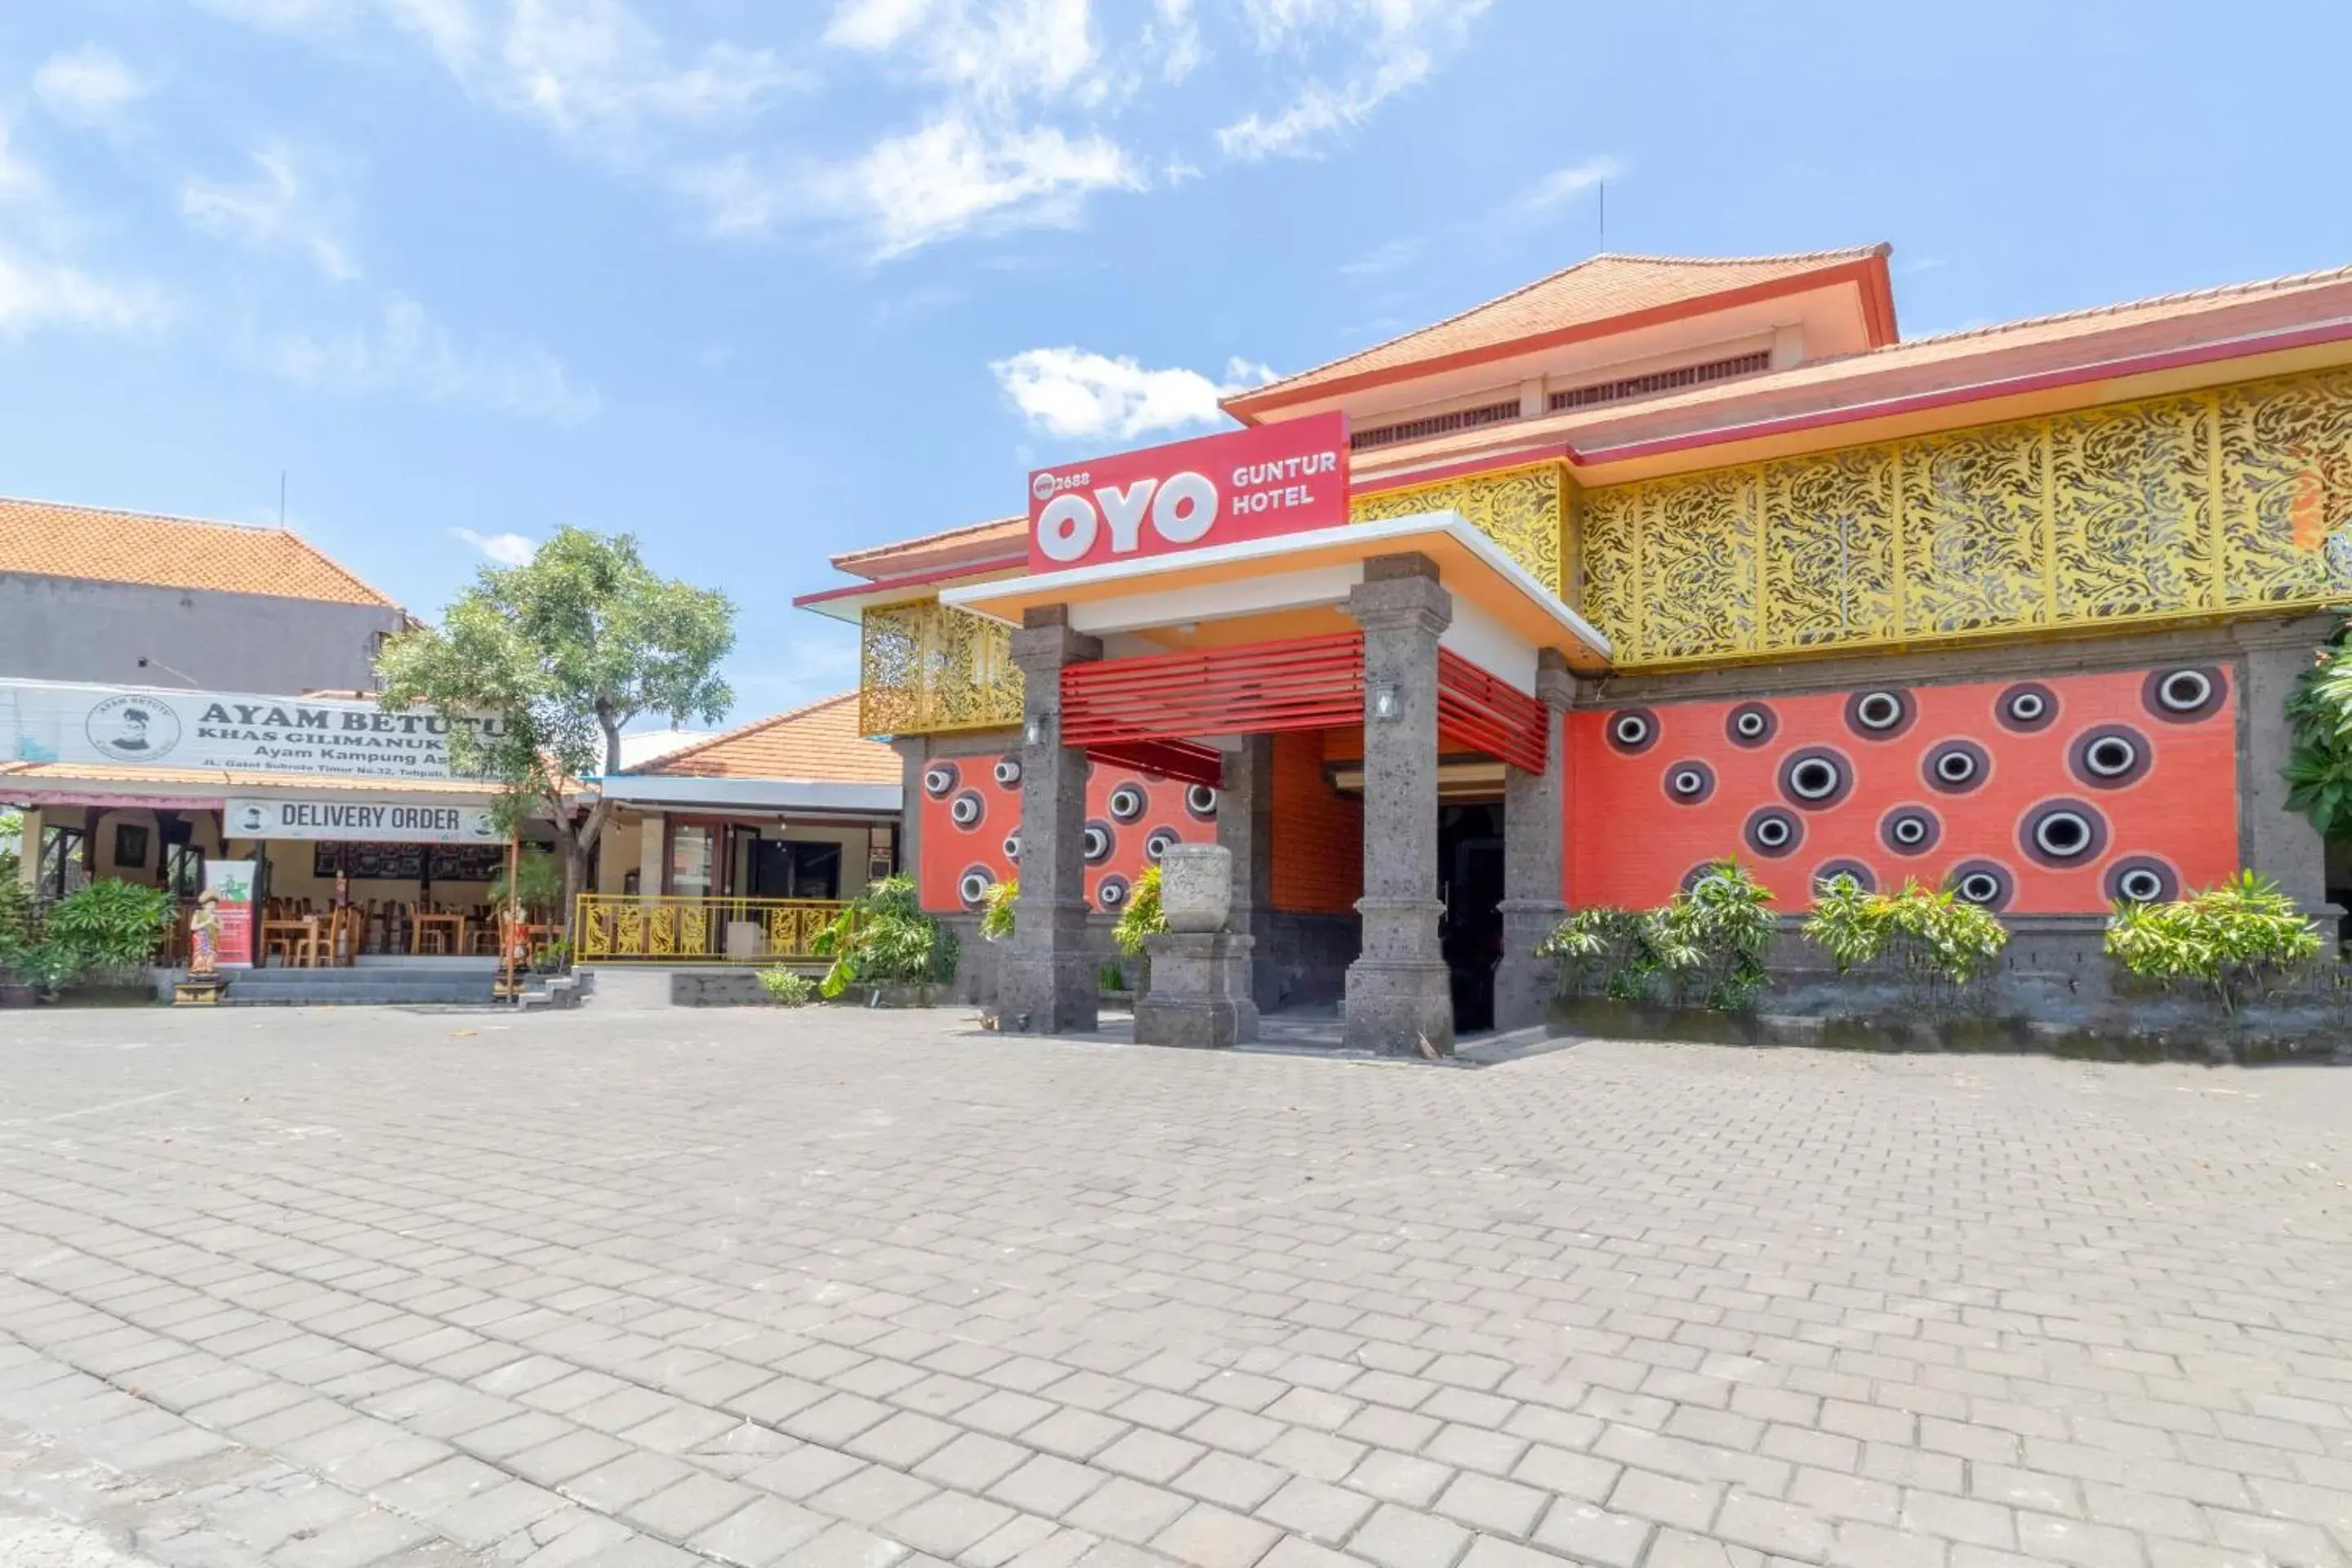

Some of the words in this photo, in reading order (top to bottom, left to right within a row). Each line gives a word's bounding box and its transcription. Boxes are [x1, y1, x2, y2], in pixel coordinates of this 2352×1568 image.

[1056, 471, 1091, 491] 2688
[1232, 451, 1336, 488] GUNTUR
[1232, 485, 1315, 515] HOTEL
[1037, 471, 1219, 562] OYO
[198, 702, 330, 729] AYAM
[198, 727, 278, 742] KHAS
[254, 745, 313, 759] Ayam
[321, 748, 416, 765] Kampung
[282, 804, 385, 827] DELIVERY
[391, 808, 460, 830] ORDER
